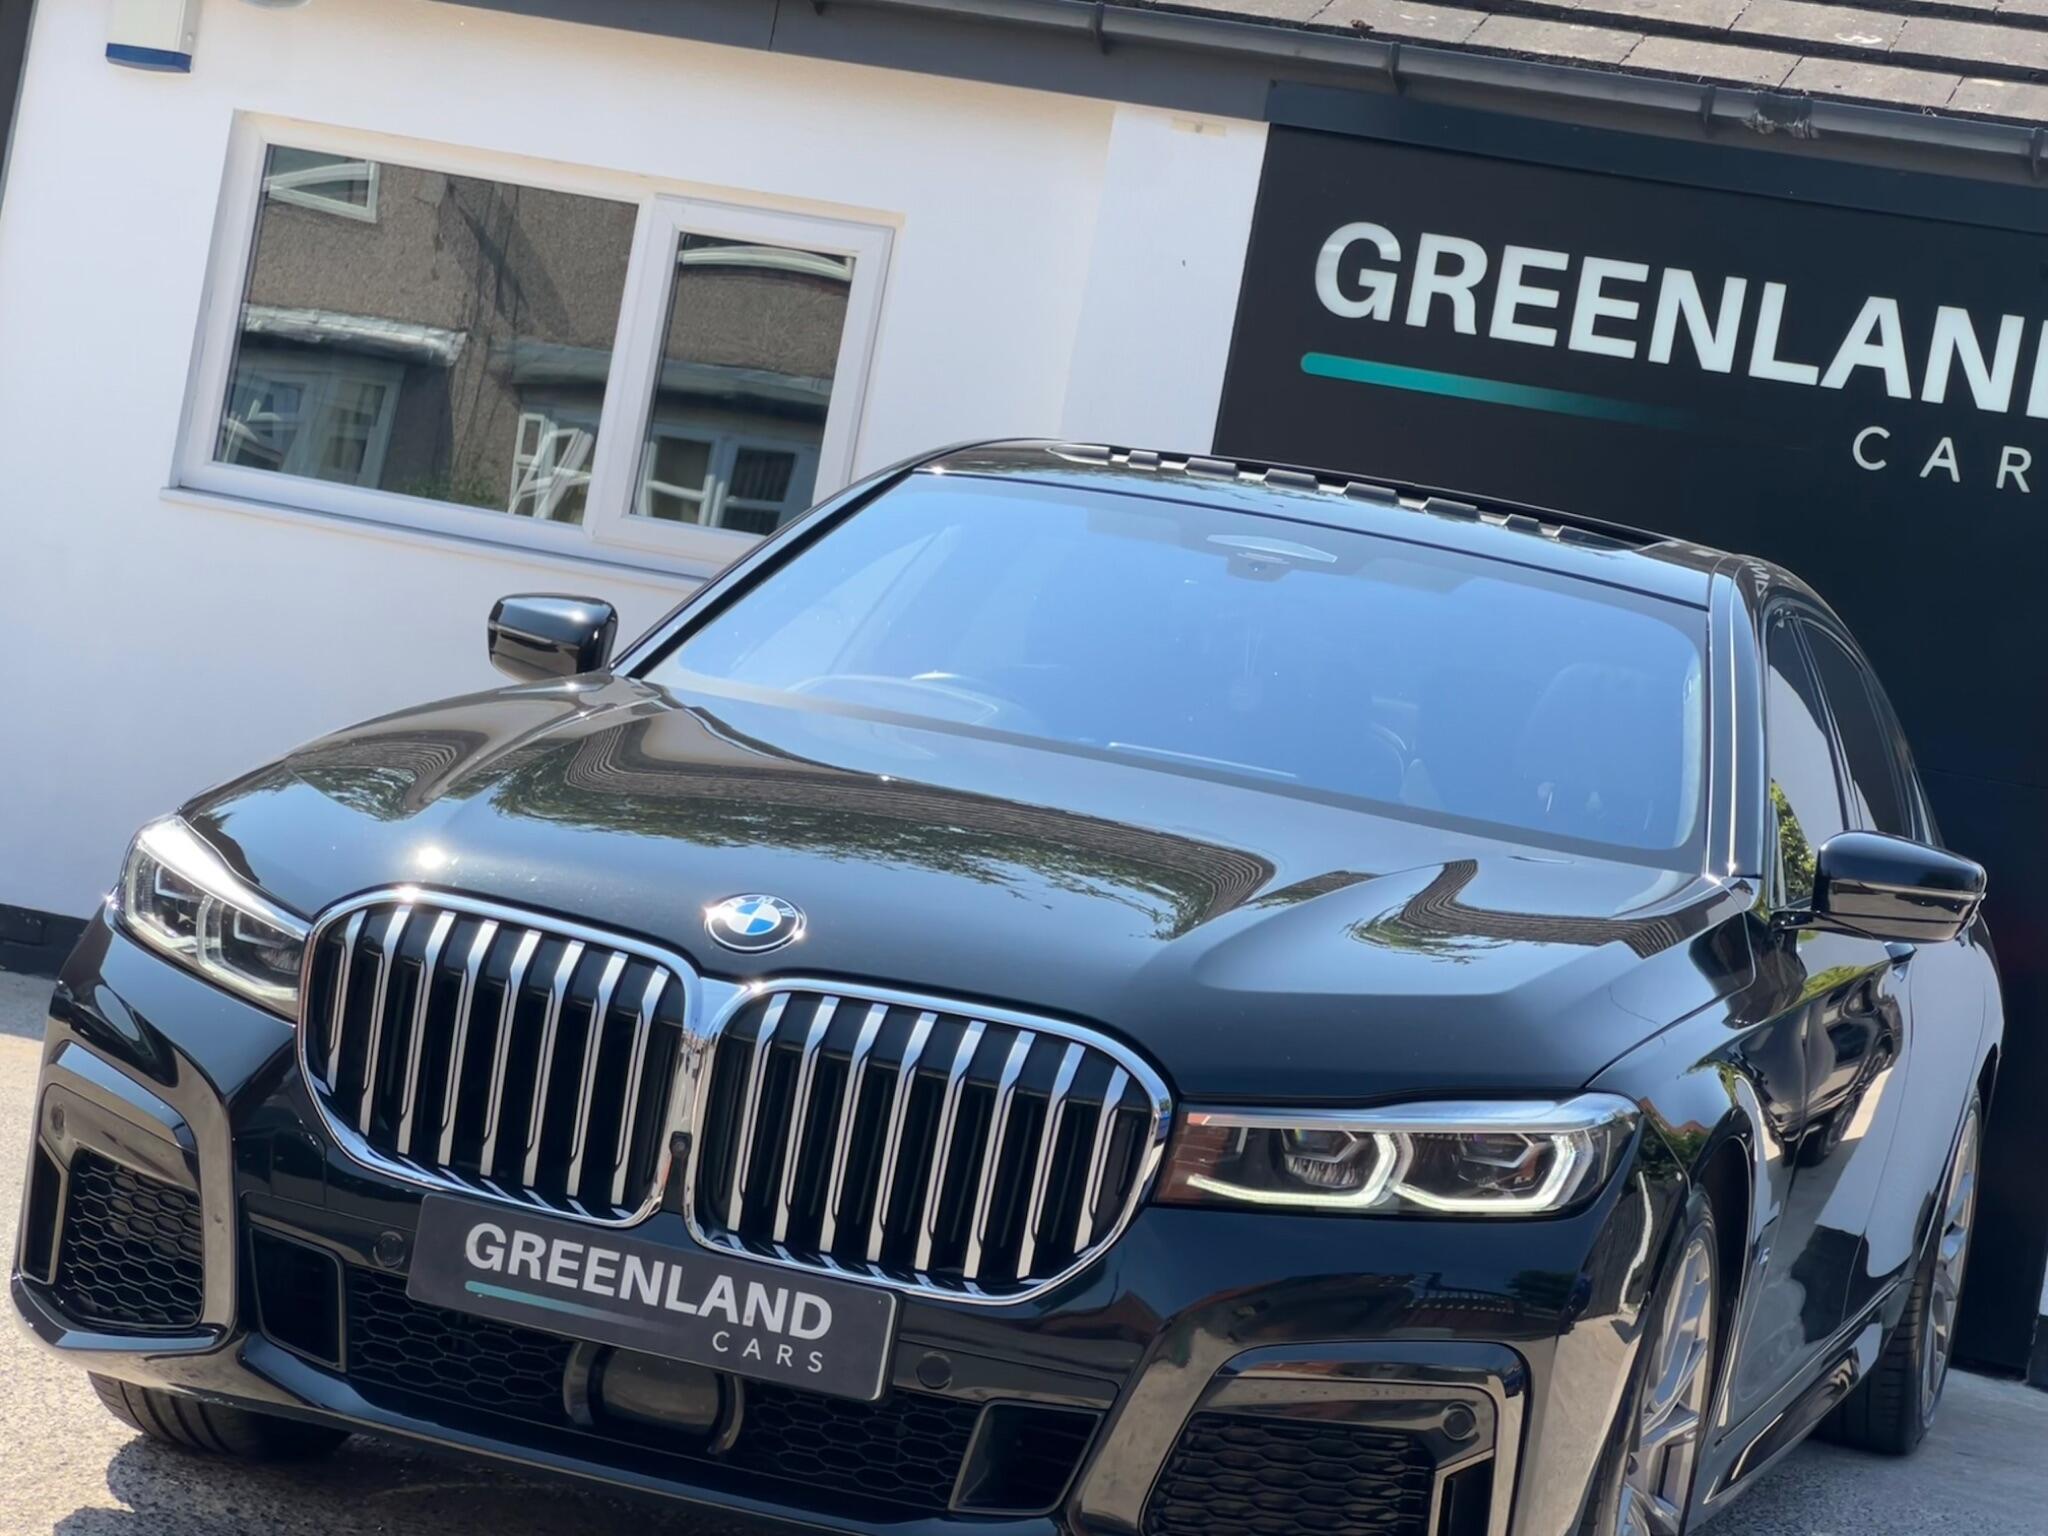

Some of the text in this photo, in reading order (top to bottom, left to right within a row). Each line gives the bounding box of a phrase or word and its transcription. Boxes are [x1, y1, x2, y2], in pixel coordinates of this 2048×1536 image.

[1315, 222, 2048, 419] GREENLAN
[1852, 426, 2032, 493] CAR
[465, 1222, 832, 1341] GREENLAND
[712, 1331, 823, 1373] CARS
